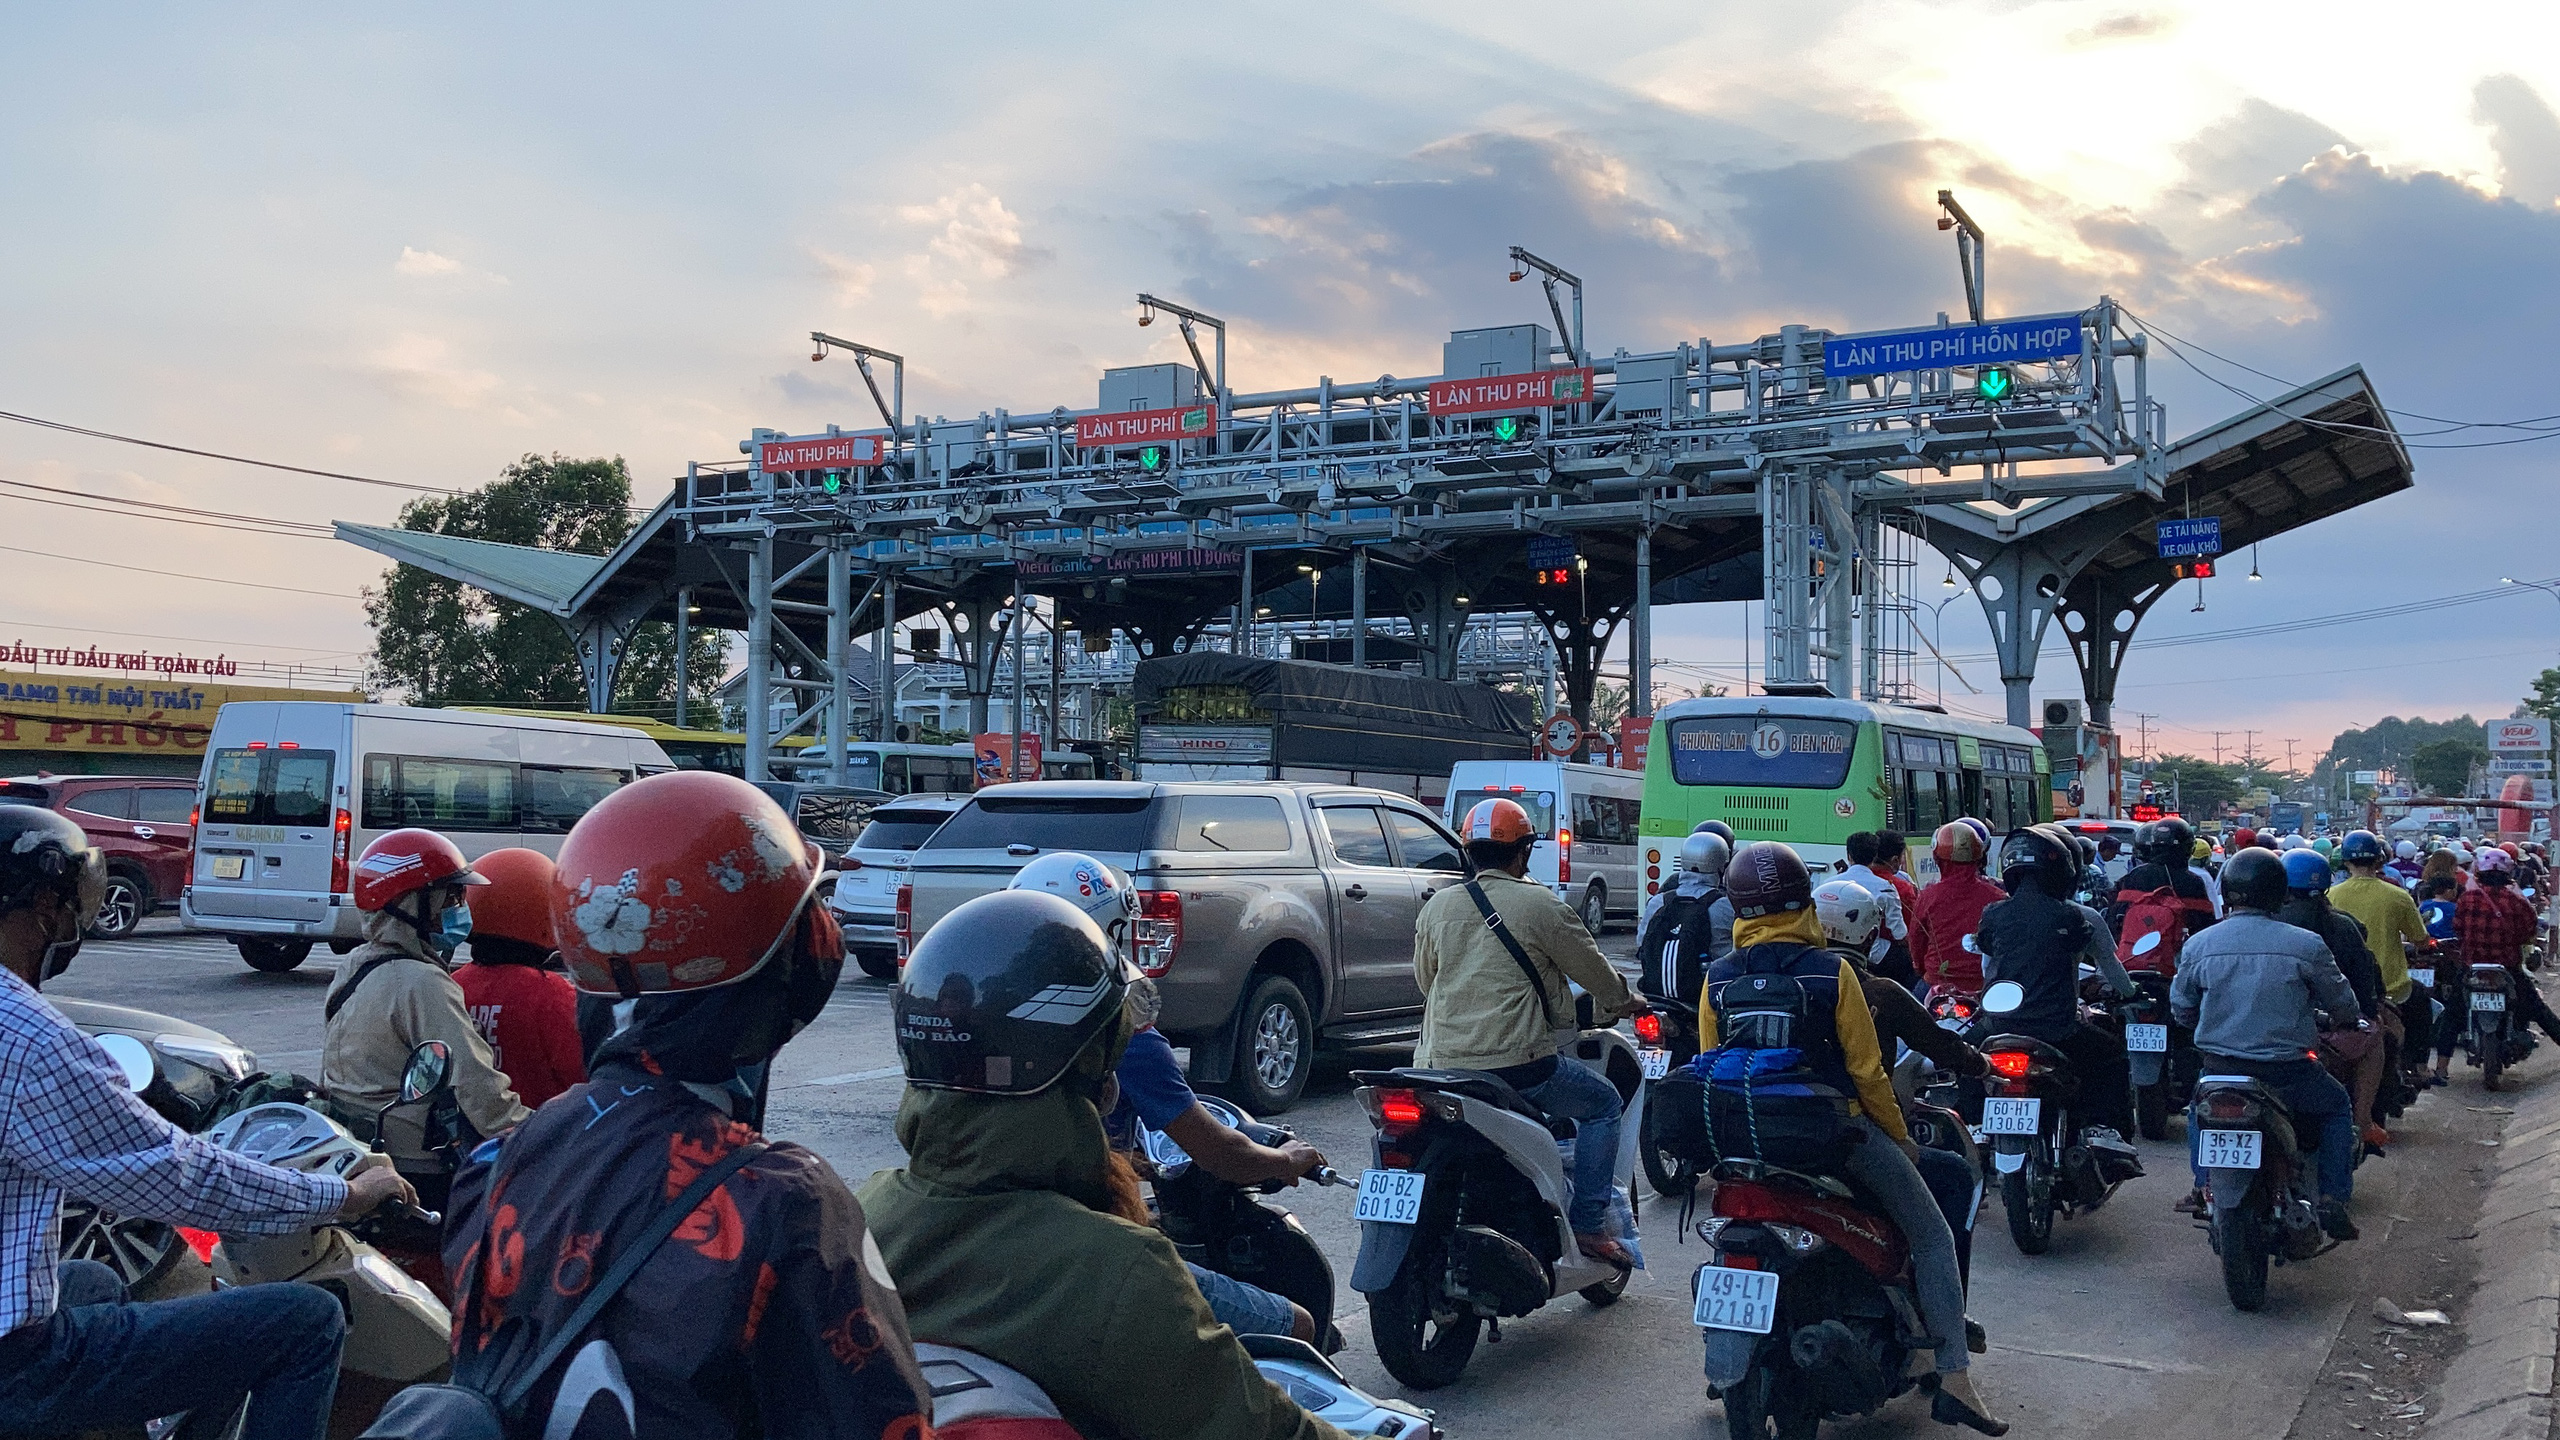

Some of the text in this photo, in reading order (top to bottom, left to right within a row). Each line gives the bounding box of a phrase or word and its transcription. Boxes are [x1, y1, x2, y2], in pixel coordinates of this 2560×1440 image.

[1833, 325, 2072, 368] LÀN THU PHÍ HỖN HỢP
[1436, 384, 1471, 407] LÀN
[1476, 383, 1511, 403] THU
[1517, 375, 1546, 399] PHÍ
[1083, 418, 1113, 439] LÀN
[1117, 418, 1148, 436] THU
[1151, 411, 1178, 433] PHÍ
[768, 441, 850, 465] LÀN THU PHÍ
[2160, 520, 2218, 539] XE TẢI NẶNG
[2164, 535, 2218, 556] XE QUÁ KHỔ
[1539, 570, 1547, 584] 3
[1817, 560, 1825, 576] 2
[2175, 564, 2183, 578] 1
[66, 682, 104, 704] TRÍ
[107, 686, 144, 714] NỘI
[149, 686, 205, 710] THẤT
[1183, 740, 1226, 748] HINO
[1723, 730, 1748, 751] LÂM
[1757, 729, 1781, 752] 16
[1790, 731, 1844, 754] BIÊN HÒA
[907, 1014, 954, 1027] HONDA
[1637, 1051, 1664, 1064] 9-E1
[1994, 1102, 2030, 1116] 60-H1
[1988, 1116, 2035, 1132] 130.62
[2208, 1149, 2252, 1166] 3792
[1370, 1174, 1415, 1197] 60-B2
[1359, 1196, 1417, 1221] 601.92
[1711, 1272, 1765, 1301] 49-L1
[1700, 1297, 1768, 1331] 021.81
